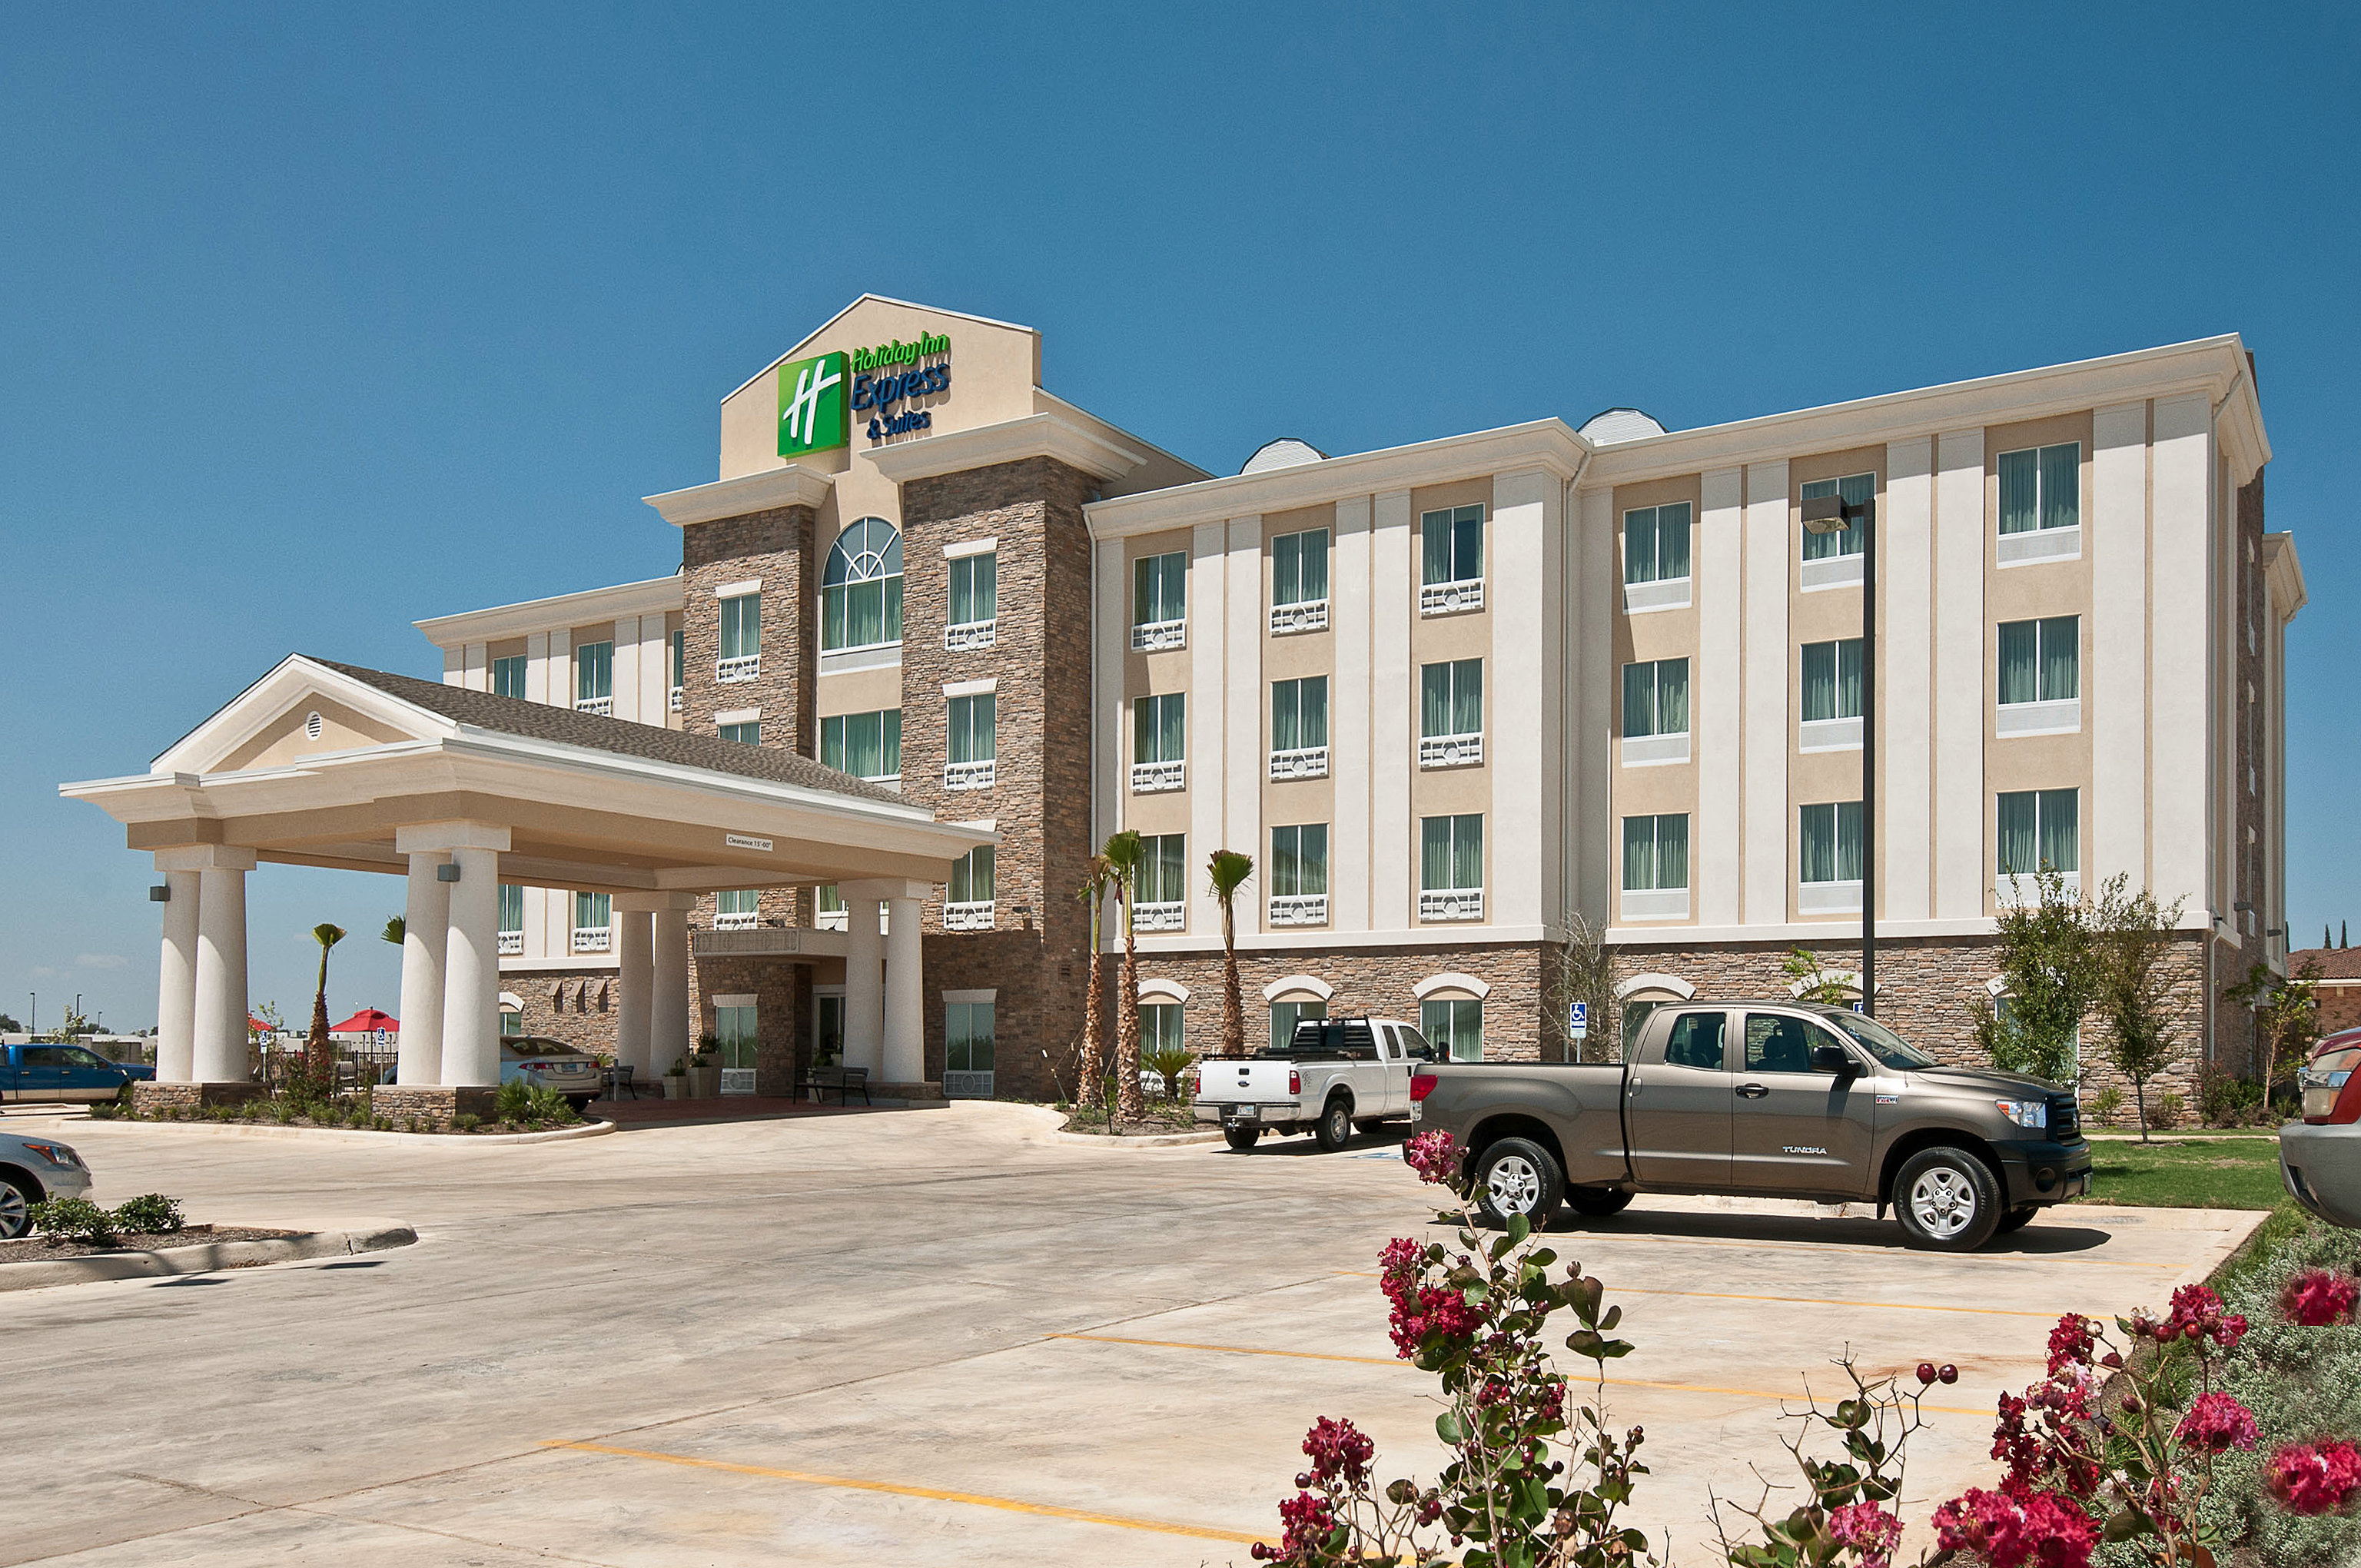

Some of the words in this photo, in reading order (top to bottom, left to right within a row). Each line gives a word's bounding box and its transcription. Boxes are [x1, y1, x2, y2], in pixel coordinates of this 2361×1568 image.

[852, 339, 920, 373] Holiday
[919, 331, 950, 355] Inn
[851, 363, 950, 414] Express
[866, 418, 885, 439] &
[882, 411, 931, 436] Suites
[728, 836, 753, 846] Clearance
[1782, 1145, 1828, 1155] TUNDRA
